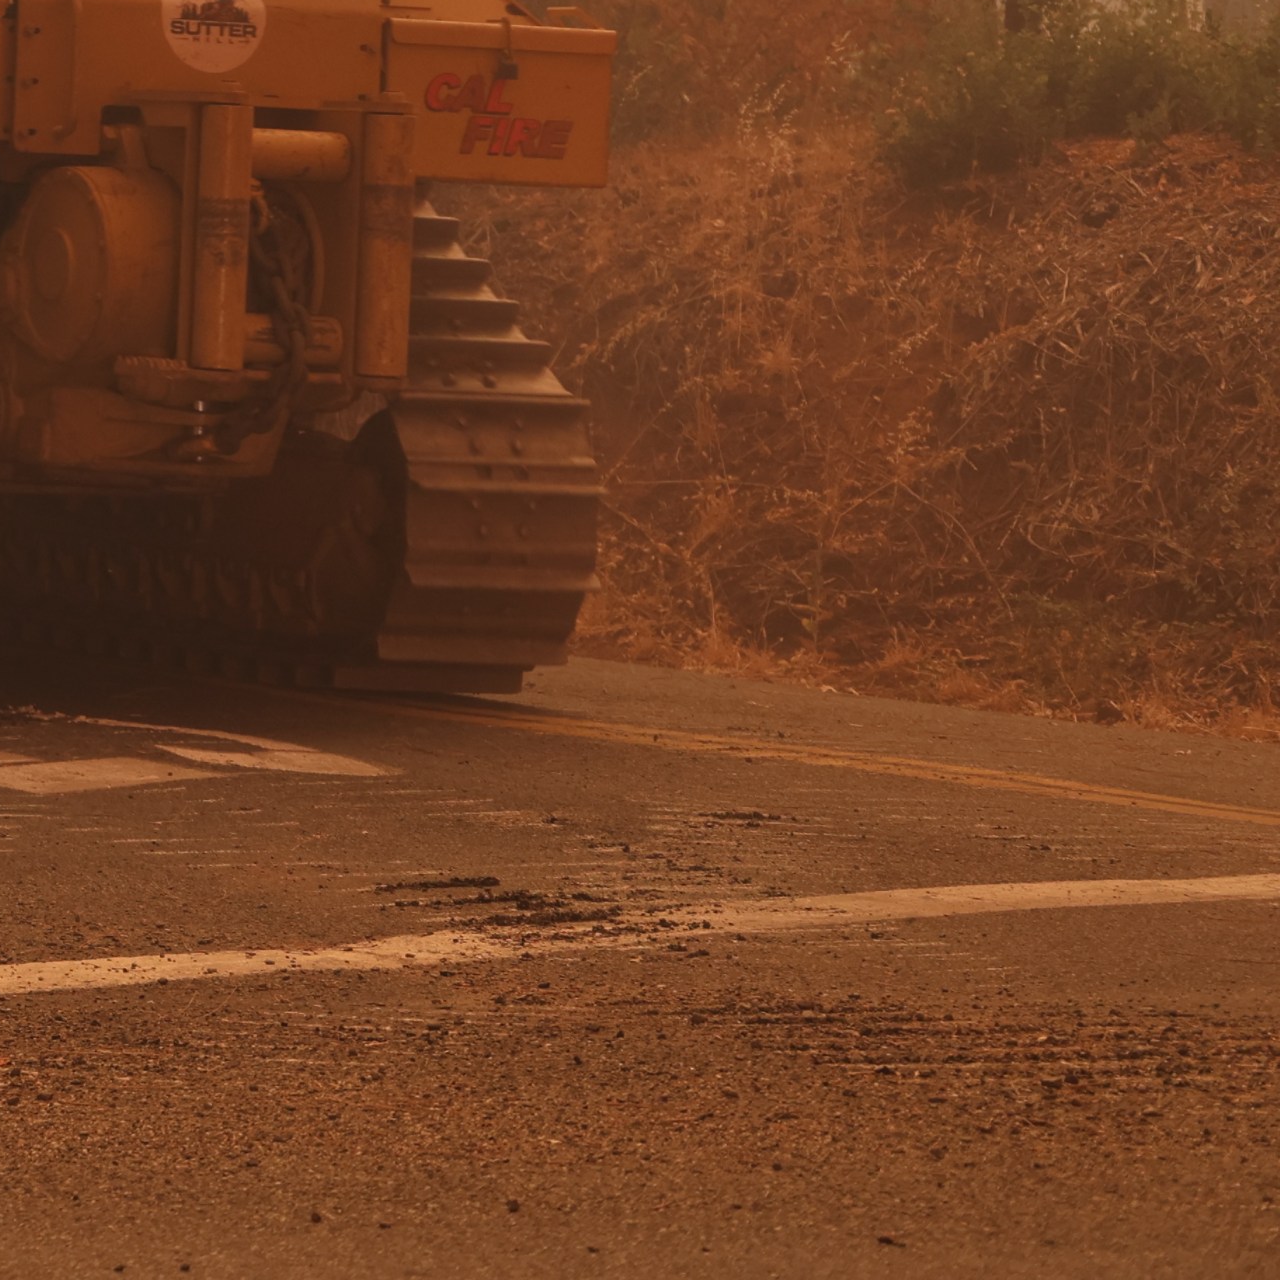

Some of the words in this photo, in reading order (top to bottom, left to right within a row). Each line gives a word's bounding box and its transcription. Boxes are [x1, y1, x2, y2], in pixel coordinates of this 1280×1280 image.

[170, 19, 257, 39] SUTTER
[424, 73, 515, 115] CAL
[459, 115, 574, 160] FIRE
